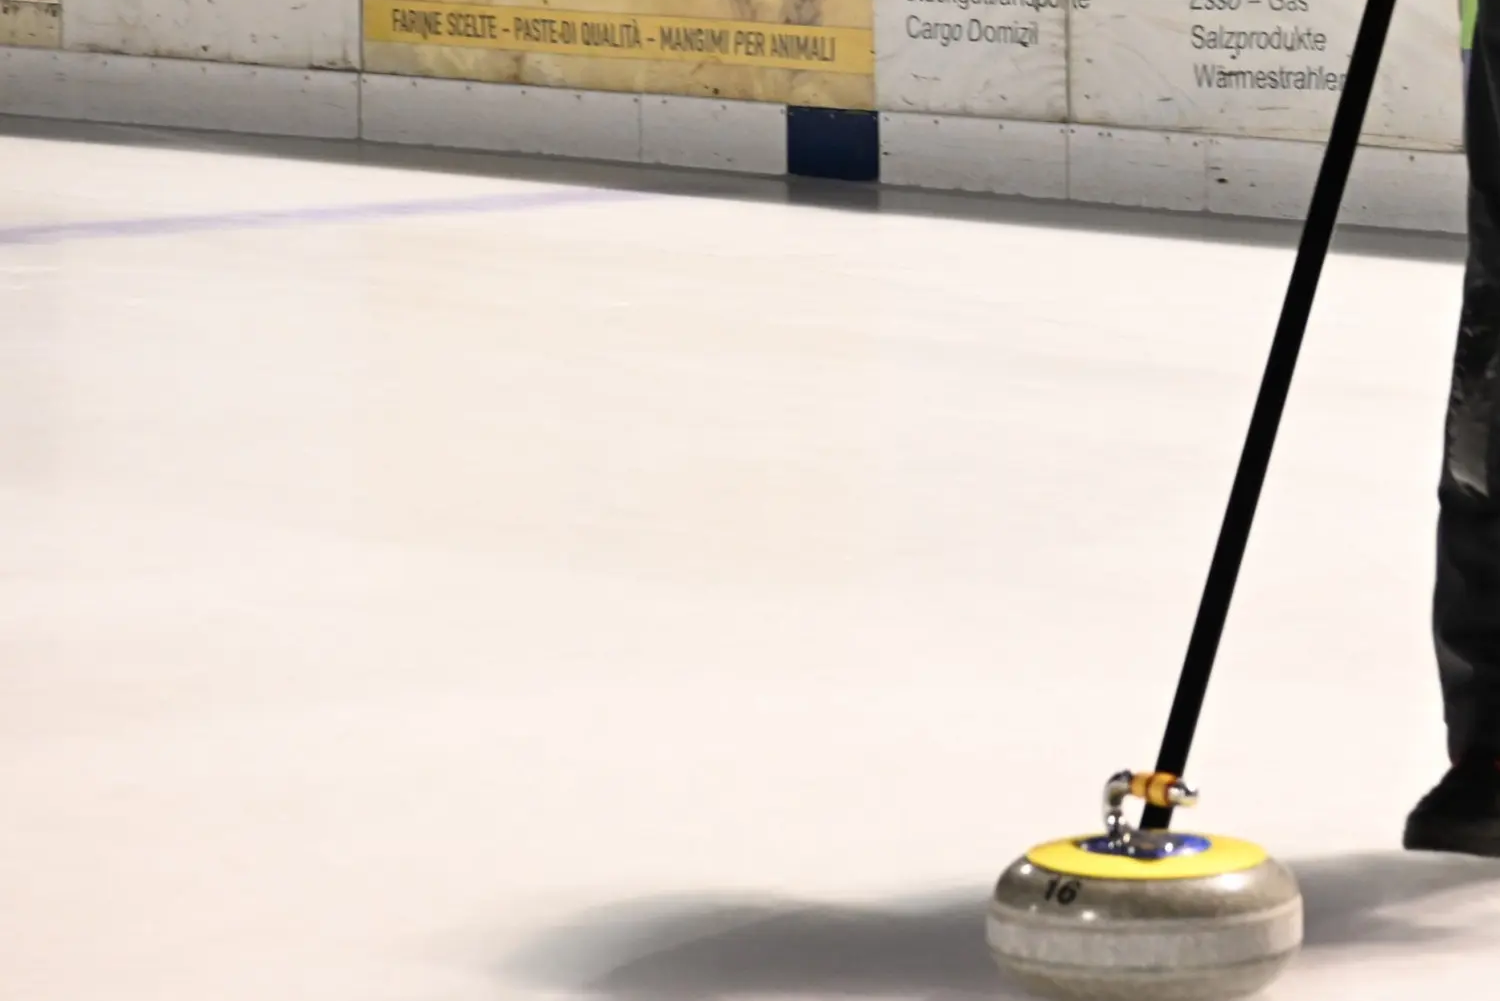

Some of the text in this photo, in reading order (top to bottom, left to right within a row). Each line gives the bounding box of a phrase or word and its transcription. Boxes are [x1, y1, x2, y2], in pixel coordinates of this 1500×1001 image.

[392, 8, 442, 37] FARINE
[447, 12, 497, 39] SCELTE
[581, 18, 641, 48] QUALITÀ
[659, 26, 730, 55] MANGIMI
[734, 29, 766, 57] PER
[770, 33, 836, 62] ANIMALI
[905, 14, 1039, 47] Cargo Domizil
[1191, 25, 1327, 57] Salzprodukte
[1043, 877, 1082, 905] 16
